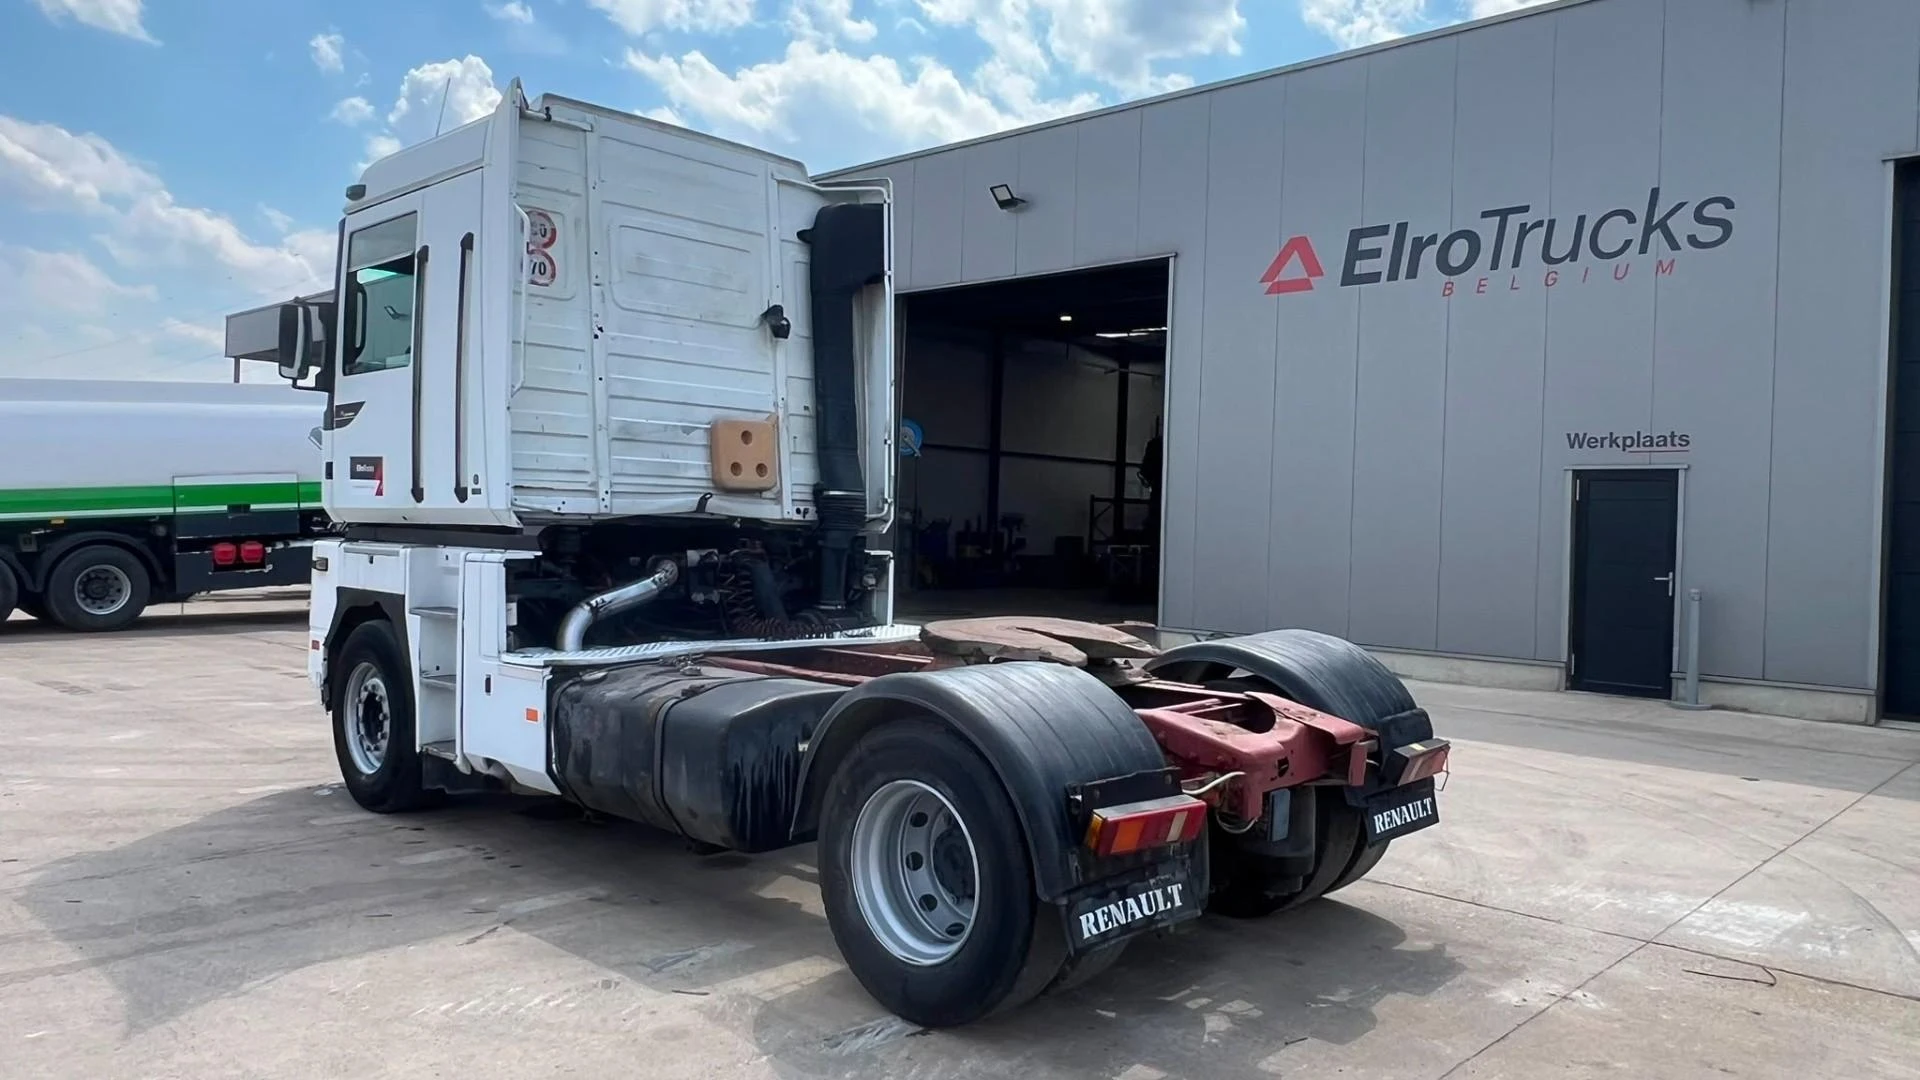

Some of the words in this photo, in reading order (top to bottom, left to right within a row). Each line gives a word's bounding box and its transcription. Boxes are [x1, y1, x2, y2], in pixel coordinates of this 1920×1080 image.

[1339, 187, 1735, 288] ElroTrucks
[1441, 258, 1676, 298] BELGIUM
[1566, 430, 1690, 452] Werkplaats
[1373, 797, 1433, 834] RENAULT
[1079, 883, 1183, 940] RENAULT
